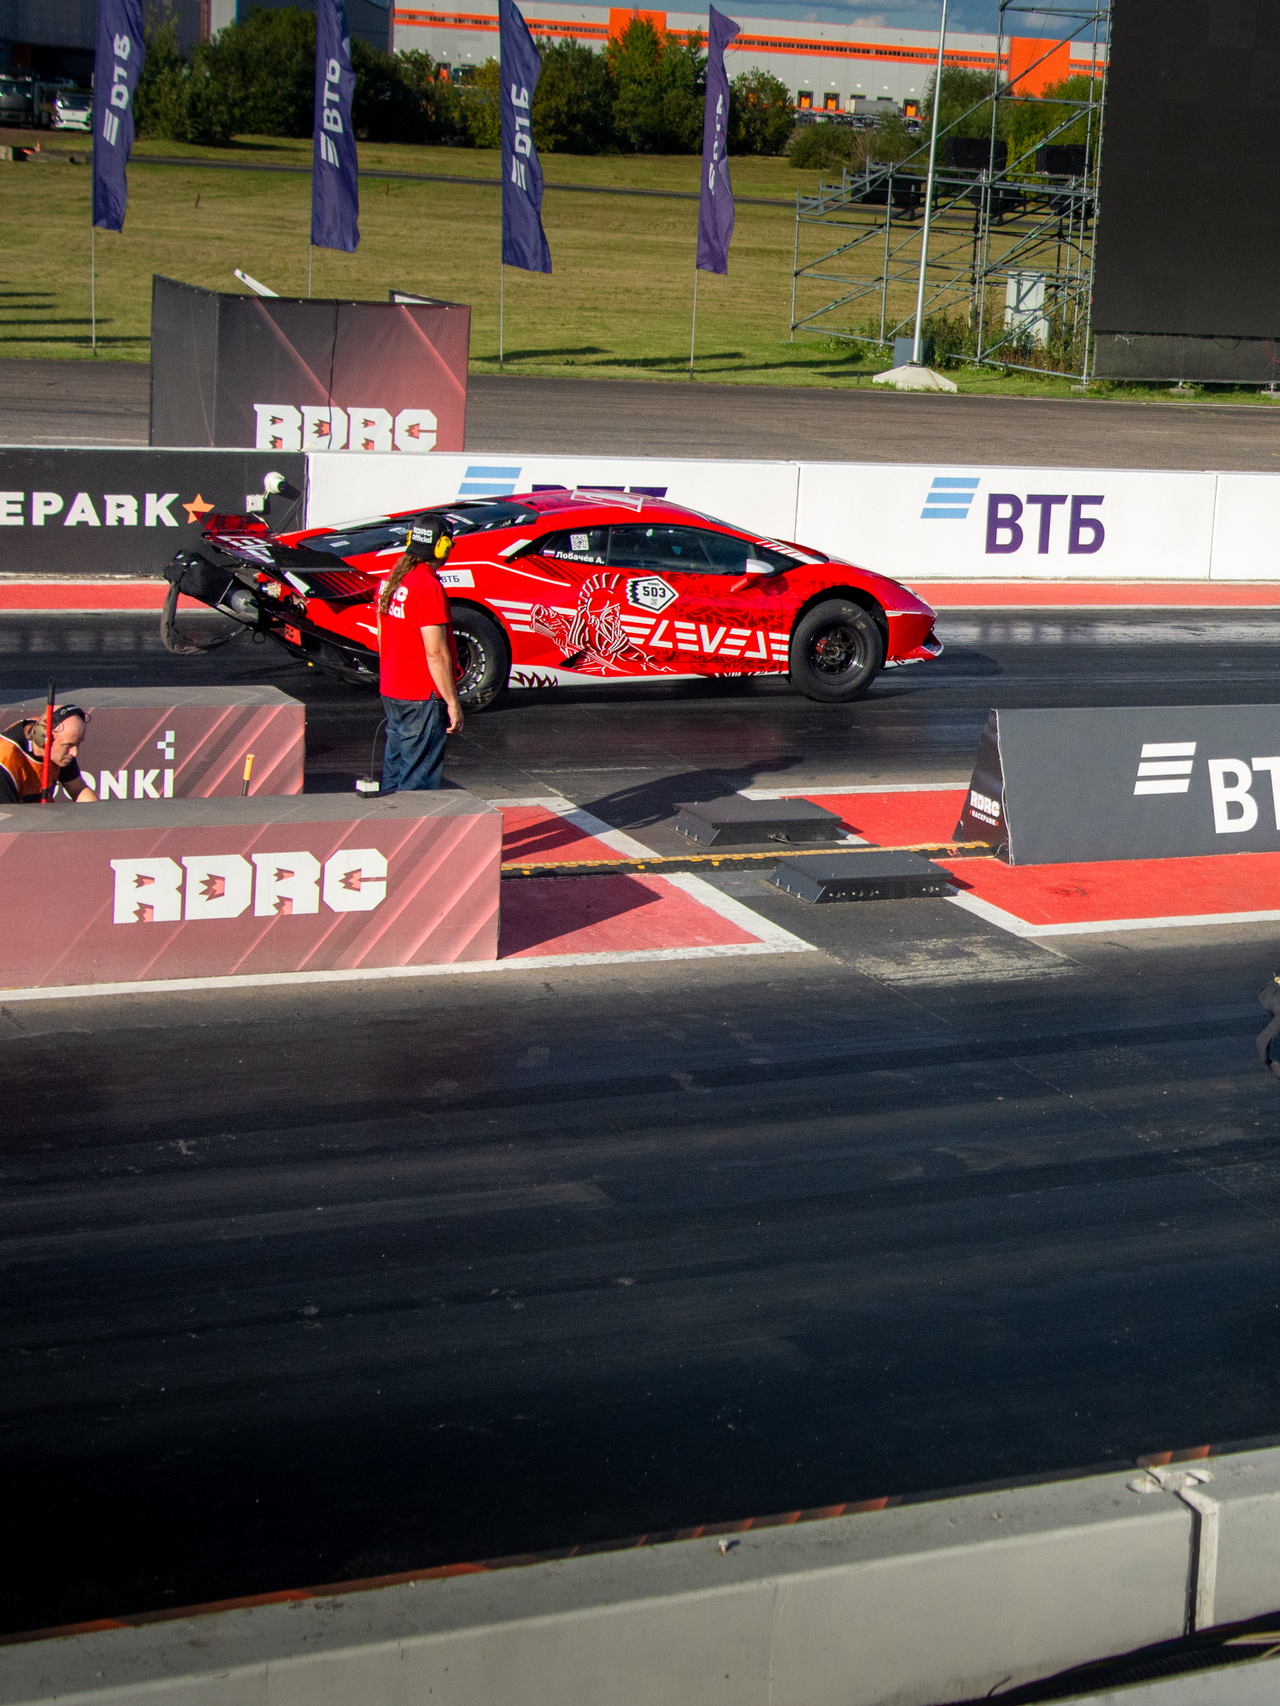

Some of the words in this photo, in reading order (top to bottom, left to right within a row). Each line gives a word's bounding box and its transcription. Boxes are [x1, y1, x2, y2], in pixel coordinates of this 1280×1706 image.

[323, 58, 344, 134] ВТБ
[254, 404, 437, 452] RDRC
[985, 493, 1106, 555] ВТБ
[441, 575, 460, 584] ВТБ
[643, 586, 666, 598] 503
[110, 848, 388, 924] RDRC
